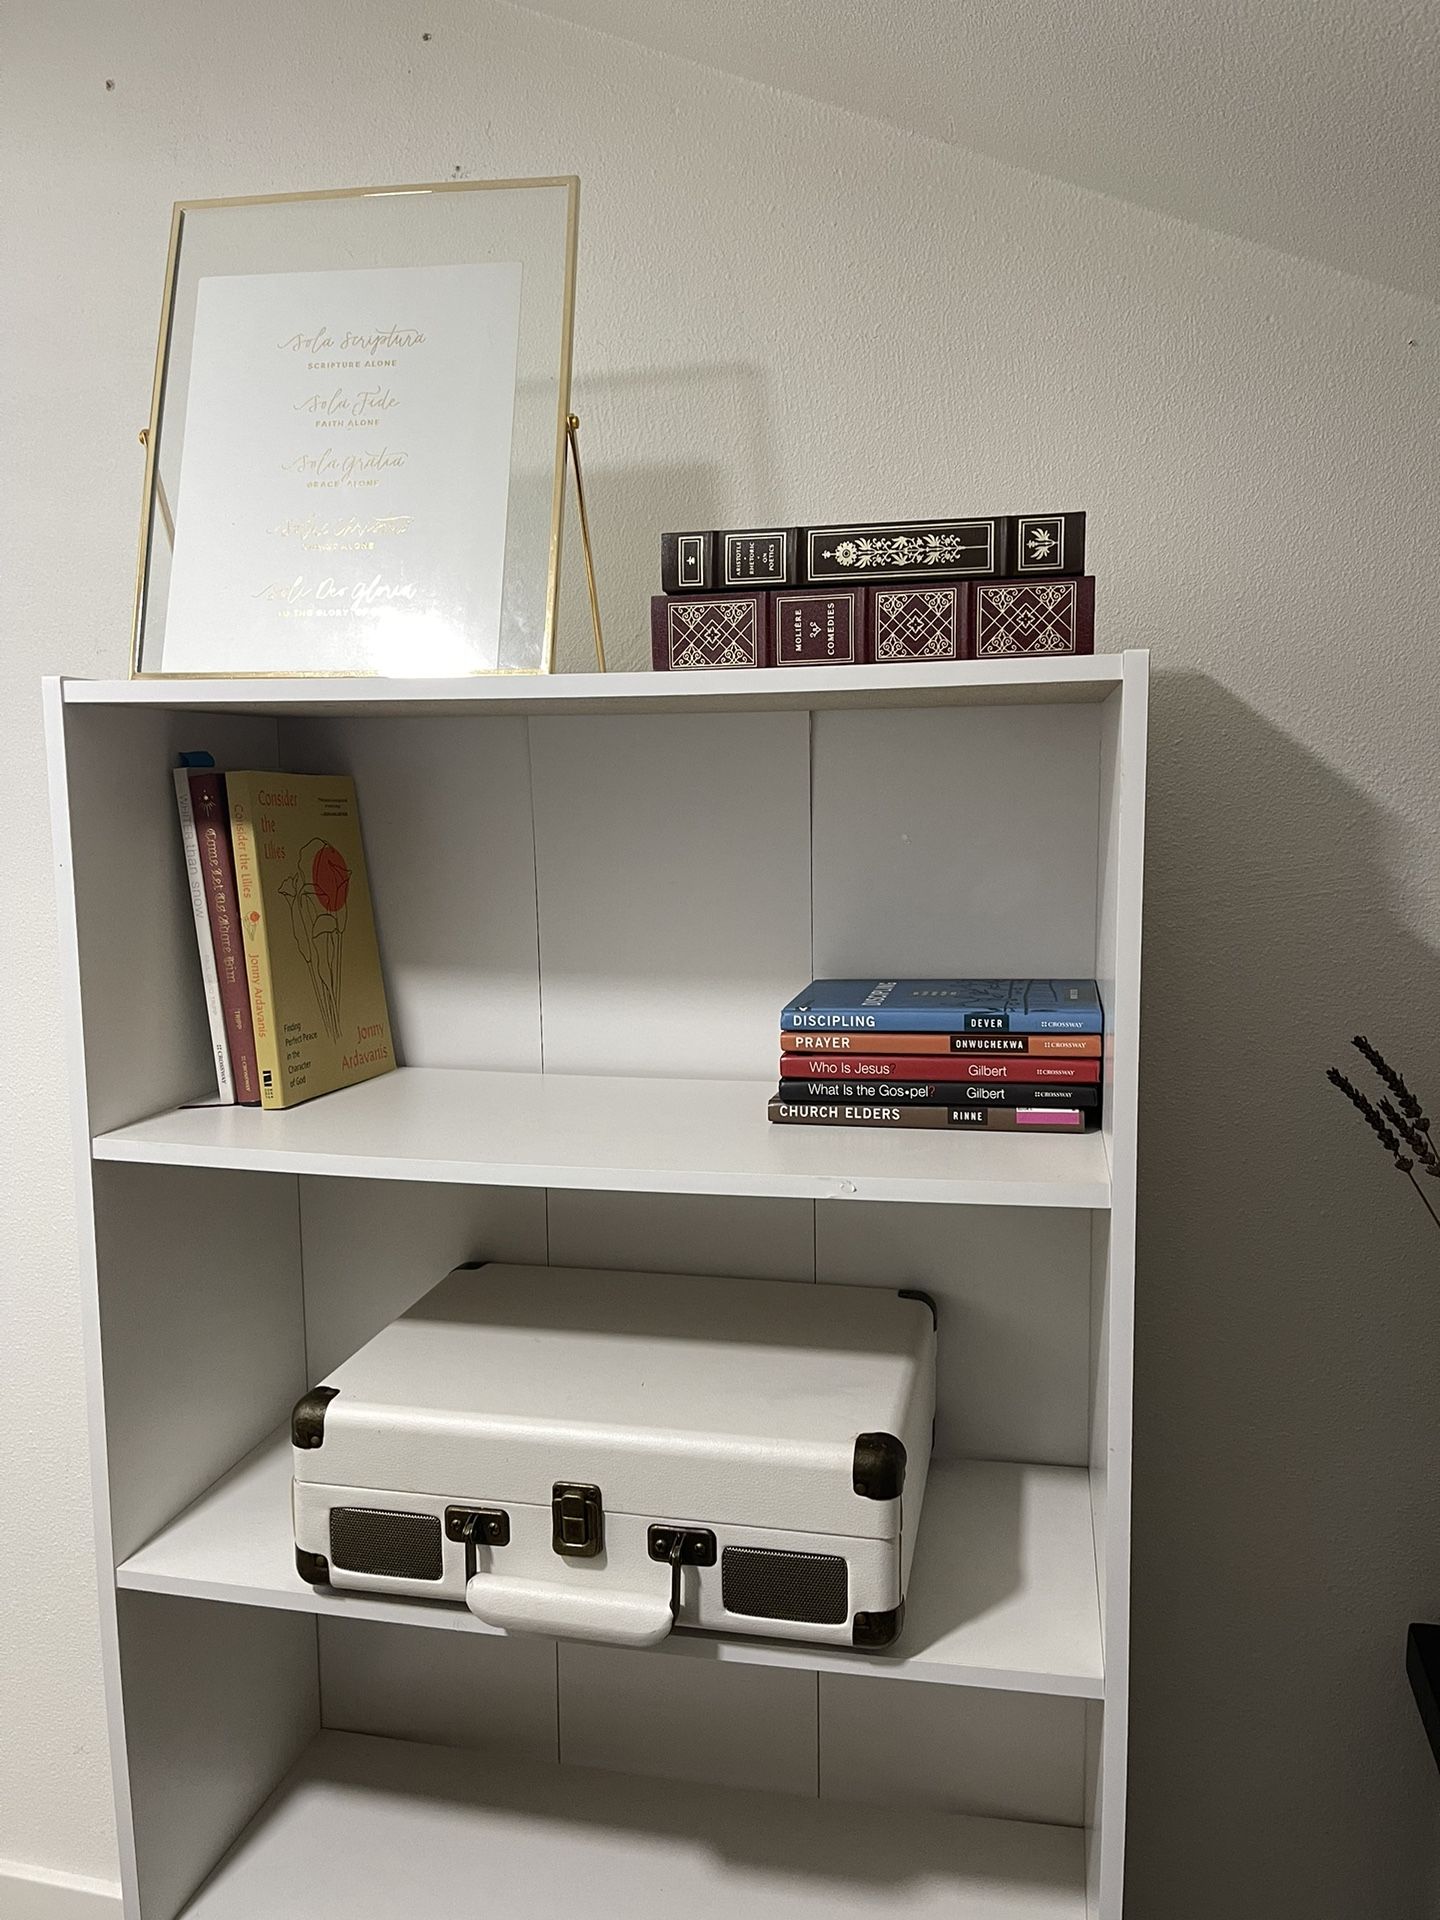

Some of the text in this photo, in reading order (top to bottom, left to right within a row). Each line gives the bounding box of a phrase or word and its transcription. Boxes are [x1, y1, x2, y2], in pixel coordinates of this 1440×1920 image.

[308, 360, 397, 370] SCRIPTURE ALONE
[315, 419, 380, 428] FAITH ALONE
[346, 479, 380, 488] ALONE
[794, 609, 802, 652] MOLIÈRE
[827, 603, 835, 656] COMEDIES
[257, 789, 298, 808] Consider
[261, 815, 276, 833] the
[234, 804, 252, 899] Consider the Lilies
[264, 841, 287, 860] Lilies
[185, 844, 199, 876] than
[191, 880, 204, 919] snow
[250, 954, 267, 1039] Jonny Ardavanis
[233, 1010, 243, 1031] TRIPP
[284, 1022, 301, 1033] Finding
[793, 1014, 876, 1028] DISCIPLING
[970, 1018, 1003, 1028] DEVER
[285, 1032, 318, 1047] Perfect Peace
[357, 1023, 384, 1044] Jonny
[795, 1036, 851, 1049] PRAYER
[955, 1039, 1024, 1049] ONWUCHEKWA
[291, 1051, 301, 1059] the
[341, 1046, 388, 1071] Ardavanis
[288, 1061, 312, 1074] Character
[809, 1061, 897, 1075] Who Is Jesus?
[968, 1064, 1007, 1077] Gilbert
[289, 1076, 307, 1088] of God
[808, 1083, 839, 1096] What
[843, 1084, 853, 1096] Is
[856, 1084, 876, 1096] the
[966, 1086, 1005, 1099] Gilbert
[779, 1105, 901, 1120] CHURCH ELDERS
[953, 1111, 983, 1121] RINNE
